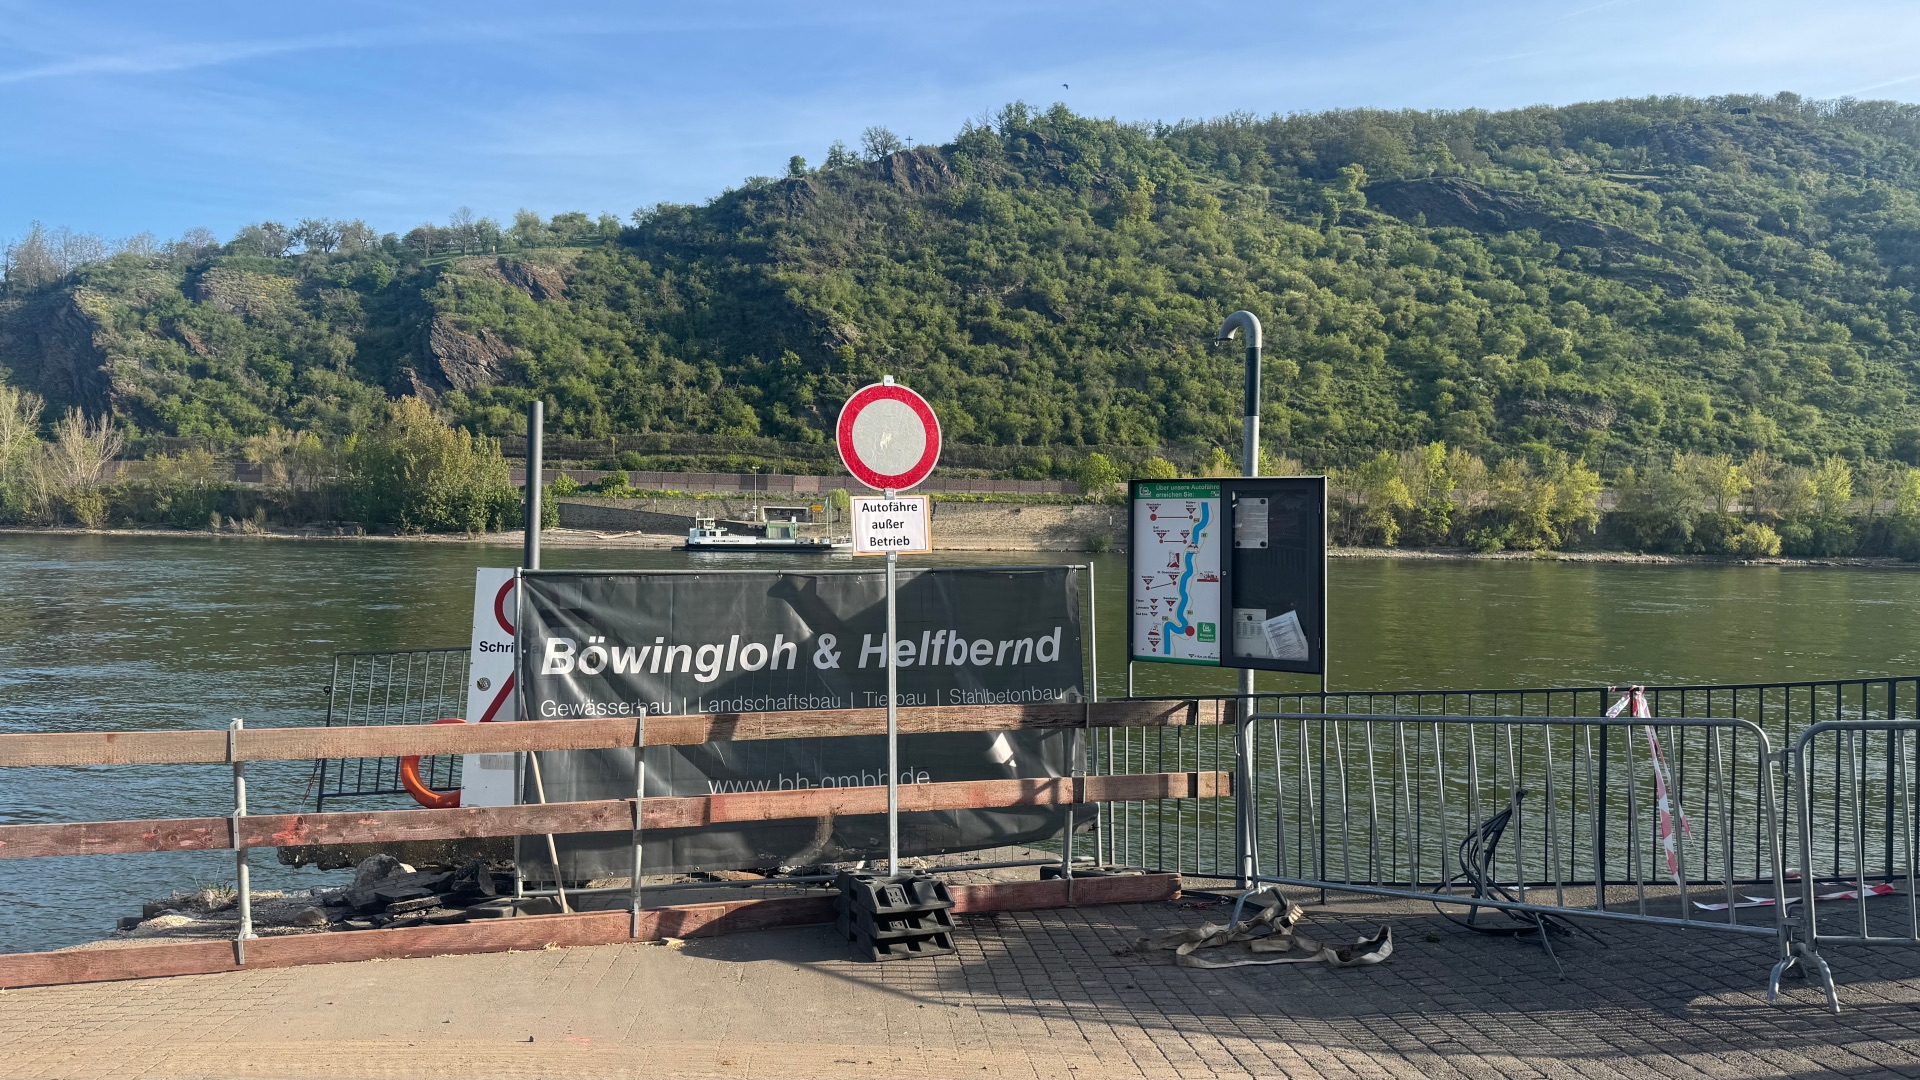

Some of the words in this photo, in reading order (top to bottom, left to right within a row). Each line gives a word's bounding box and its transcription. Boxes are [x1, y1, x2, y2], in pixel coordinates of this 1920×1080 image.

[862, 502, 918, 512] Autofähre
[872, 519, 904, 529] außer
[870, 536, 910, 546] Betrieb
[479, 641, 514, 653] Schri
[541, 634, 797, 682] Böwingloh
[813, 633, 841, 670] &
[858, 627, 1062, 669] Helfbernd
[540, 699, 672, 717] Gewässerbau
[698, 694, 841, 713] Landschaftsbau
[863, 691, 926, 706] Tiebau
[950, 686, 1063, 705] Stahlbetonbau
[708, 766, 930, 794] wwwbh-mbhde
